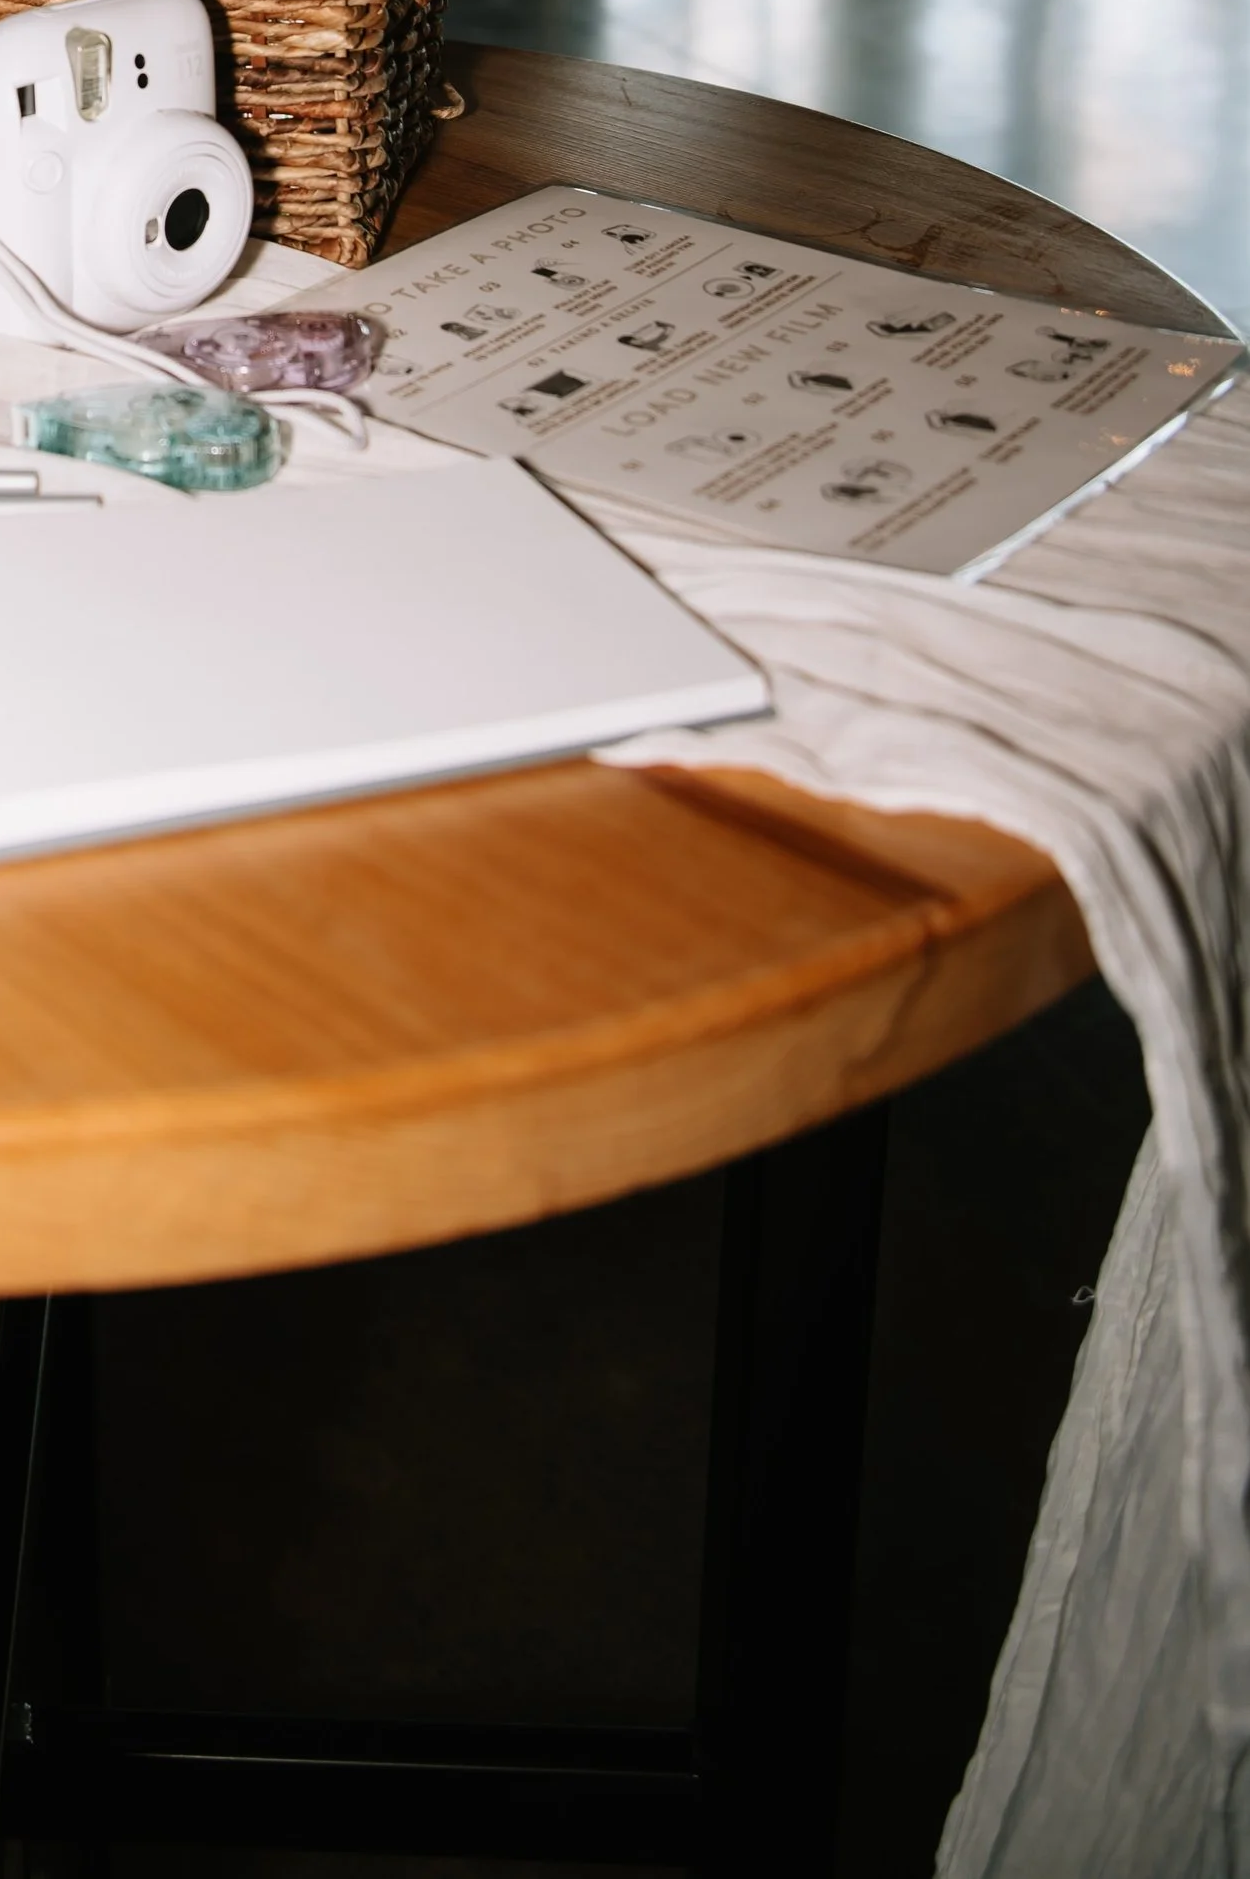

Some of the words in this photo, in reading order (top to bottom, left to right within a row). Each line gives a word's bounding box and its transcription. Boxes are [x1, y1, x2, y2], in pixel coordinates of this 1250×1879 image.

[391, 263, 470, 299] TAKE
[470, 252, 497, 265] A
[491, 207, 587, 253] PHOTO
[601, 387, 698, 438] LOAD
[692, 343, 772, 387] NEW
[766, 302, 843, 345] FILM
